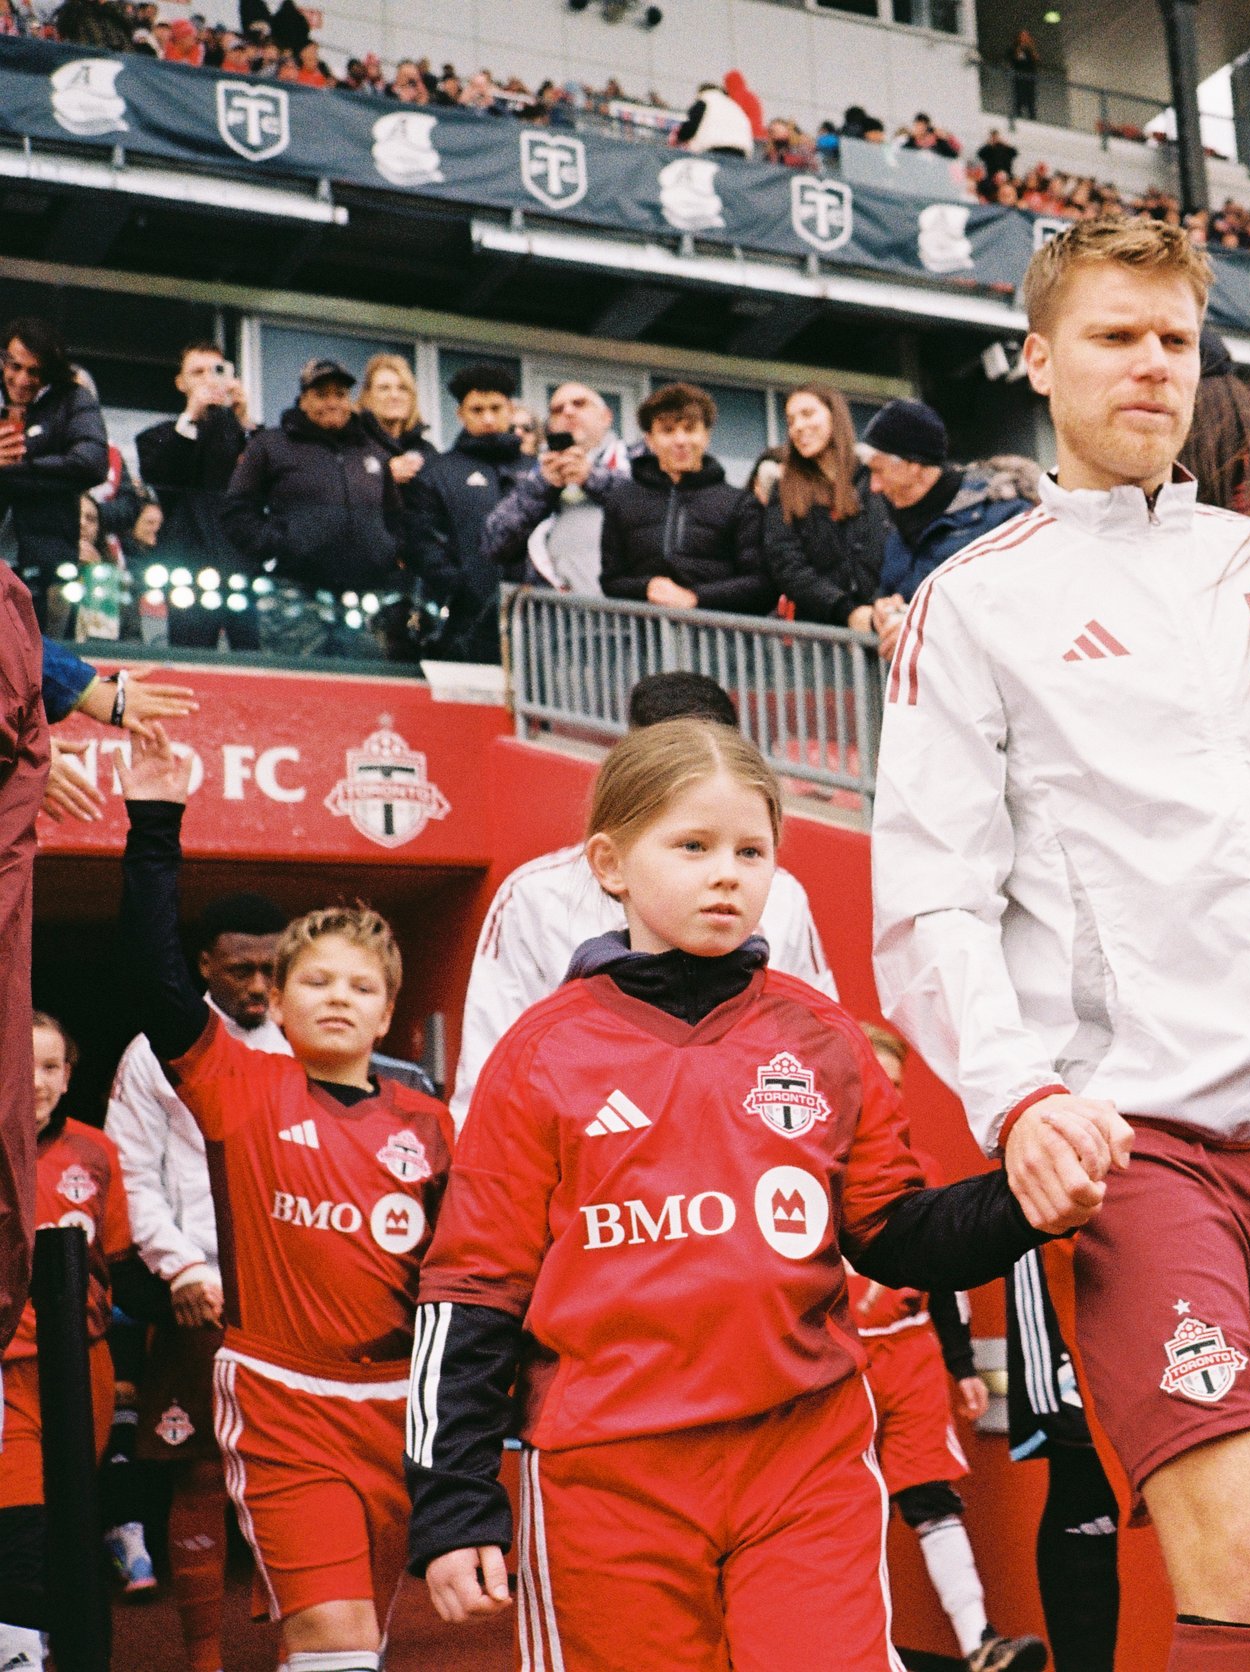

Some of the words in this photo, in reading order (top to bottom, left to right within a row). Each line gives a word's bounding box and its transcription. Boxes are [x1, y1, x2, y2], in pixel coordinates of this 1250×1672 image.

[221, 744, 306, 803] FC
[755, 1092, 816, 1107] TORONTO
[271, 1190, 362, 1233] BMO
[579, 1191, 736, 1250] BMO
[1170, 1351, 1231, 1377] TORONTO
